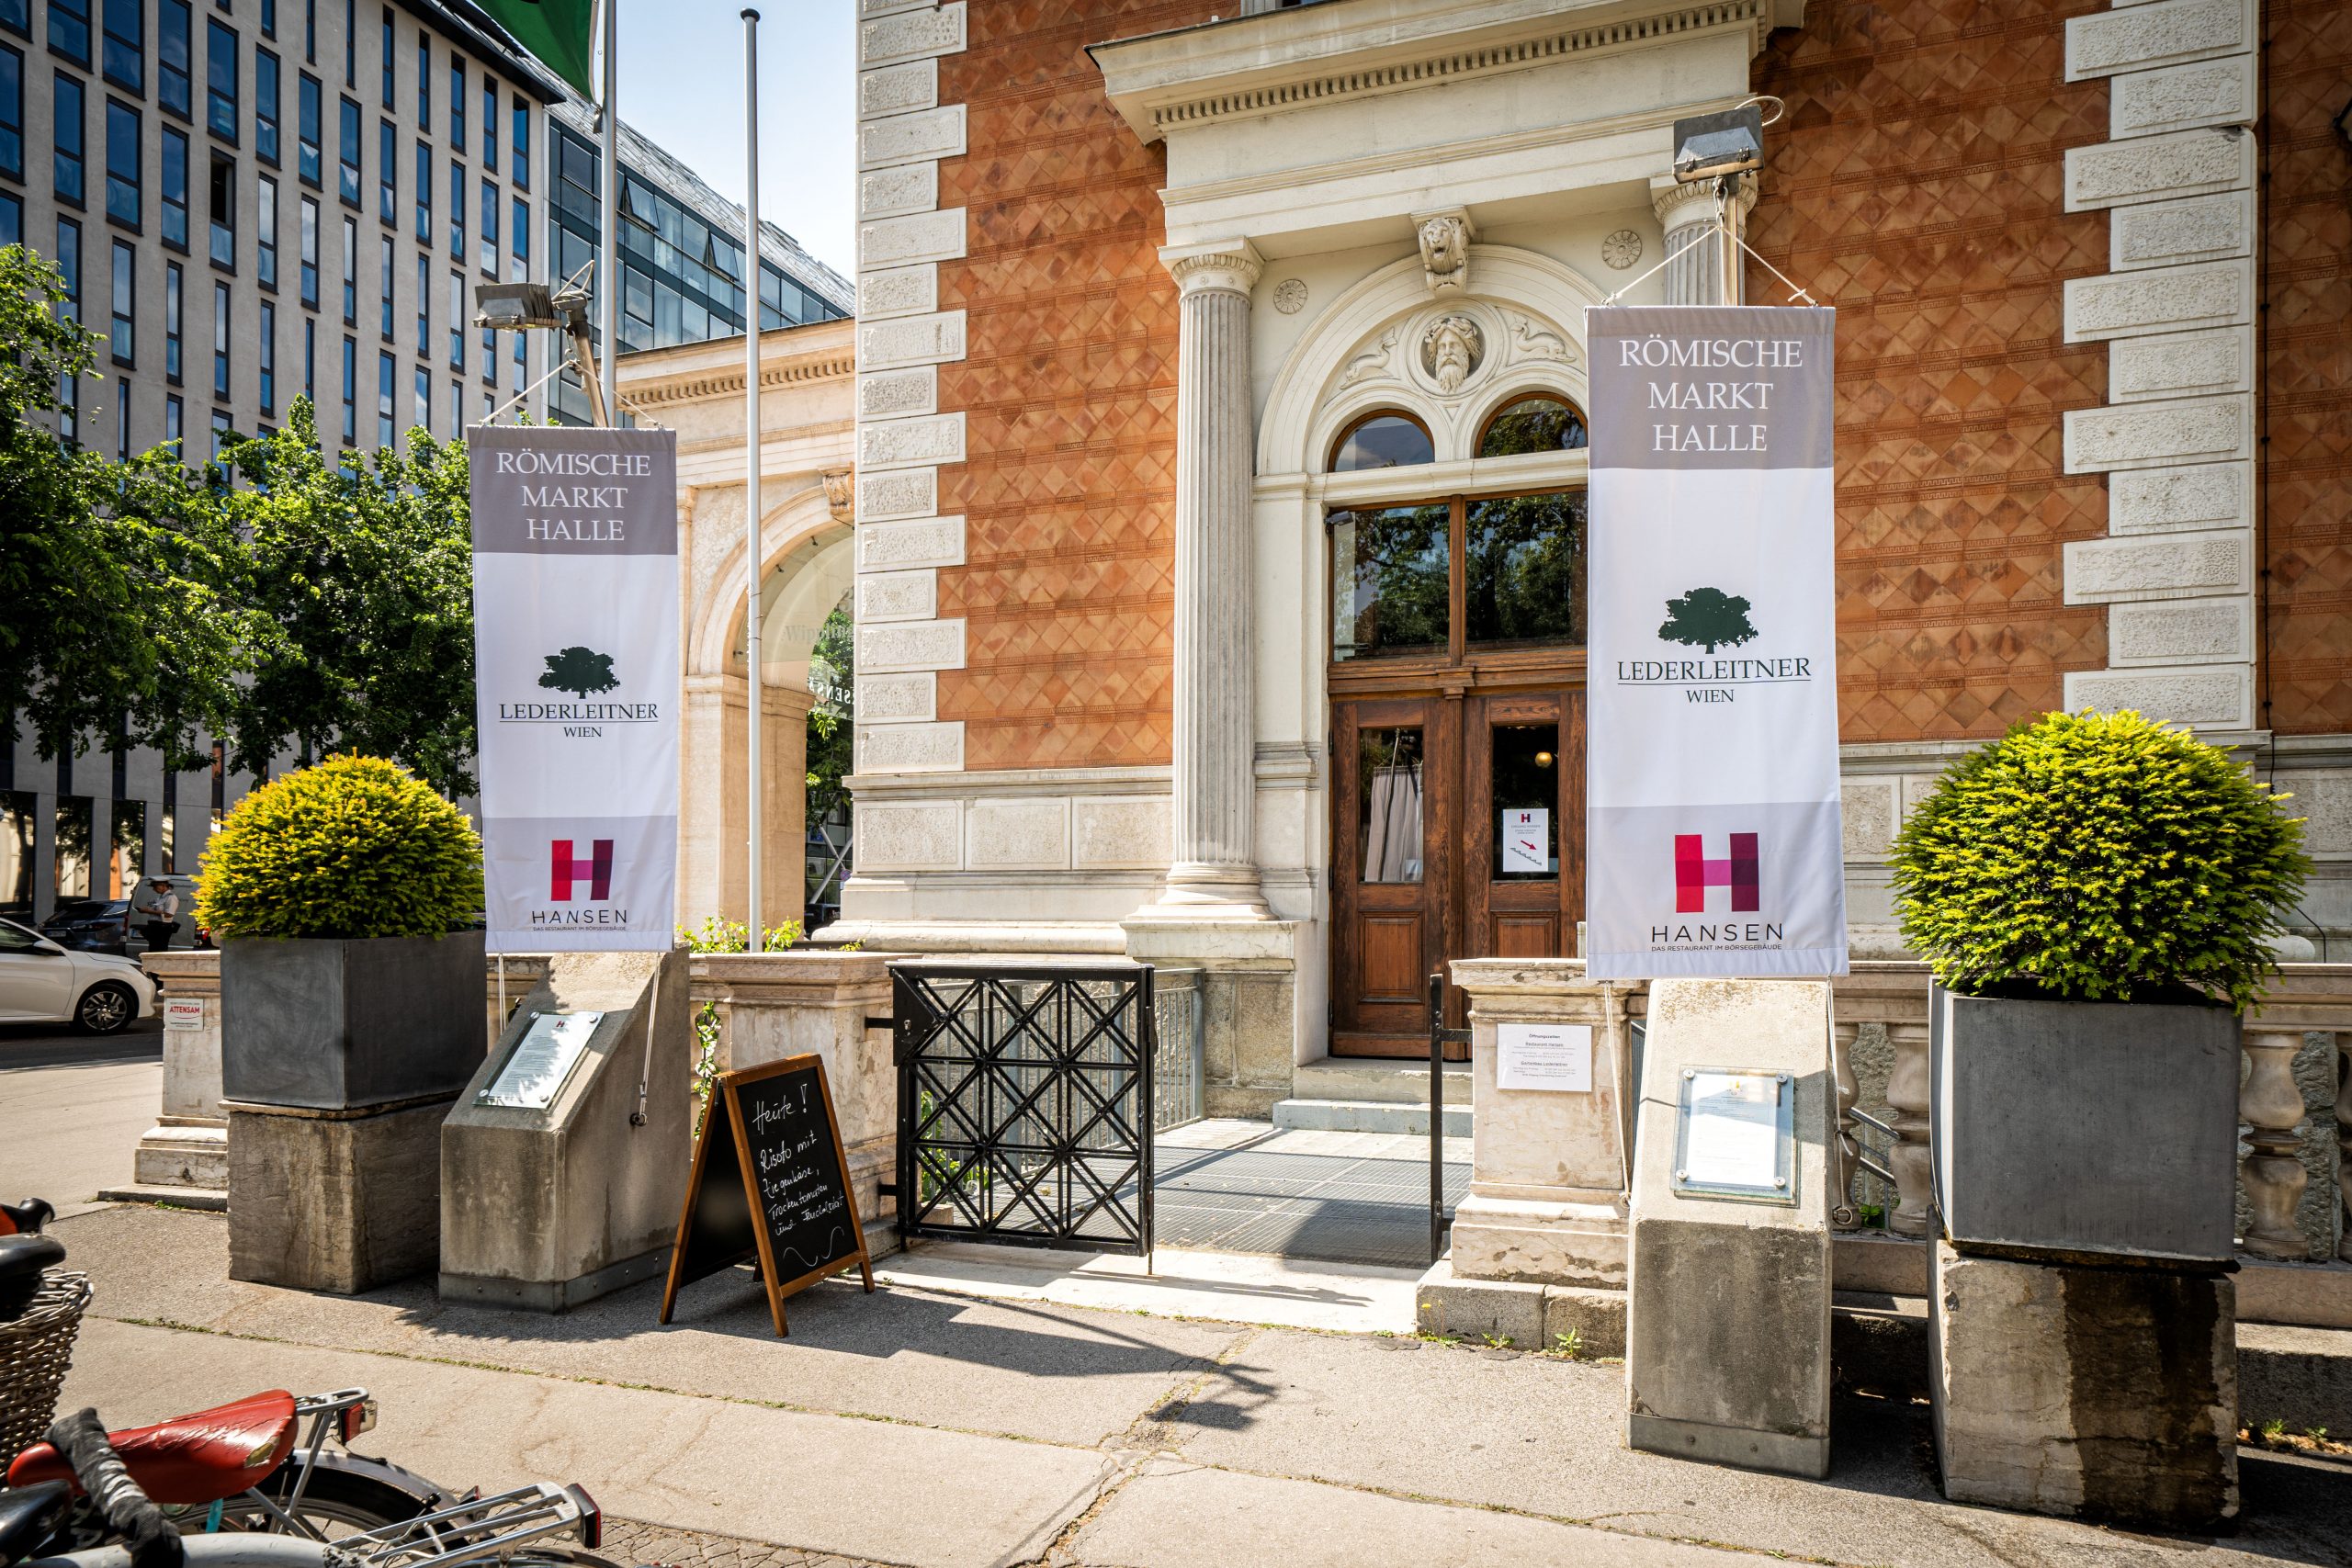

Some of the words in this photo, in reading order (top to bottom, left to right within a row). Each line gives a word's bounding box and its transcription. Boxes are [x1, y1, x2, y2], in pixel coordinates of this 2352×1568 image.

[1619, 333, 1804, 367] RÖMISCHE
[1647, 382, 1774, 410] MARKT
[1652, 424, 1768, 452] HALLE
[496, 448, 651, 477] RÖMISCHE
[521, 485, 628, 509] MARKT
[526, 518, 626, 542] HALLE
[1617, 657, 1812, 682] LEDERLEITNER
[1686, 689, 1735, 704] WIEN
[499, 703, 660, 720] LEDERLEITNER
[563, 727, 603, 738] WIEN
[532, 909, 628, 924] HANSEN
[1651, 923, 1783, 942] HANSEN
[1724, 943, 1782, 952] BÖRSEGEBÄUDE
[169, 1005, 200, 1014] ATTENSAM
[797, 1129, 818, 1154] mit
